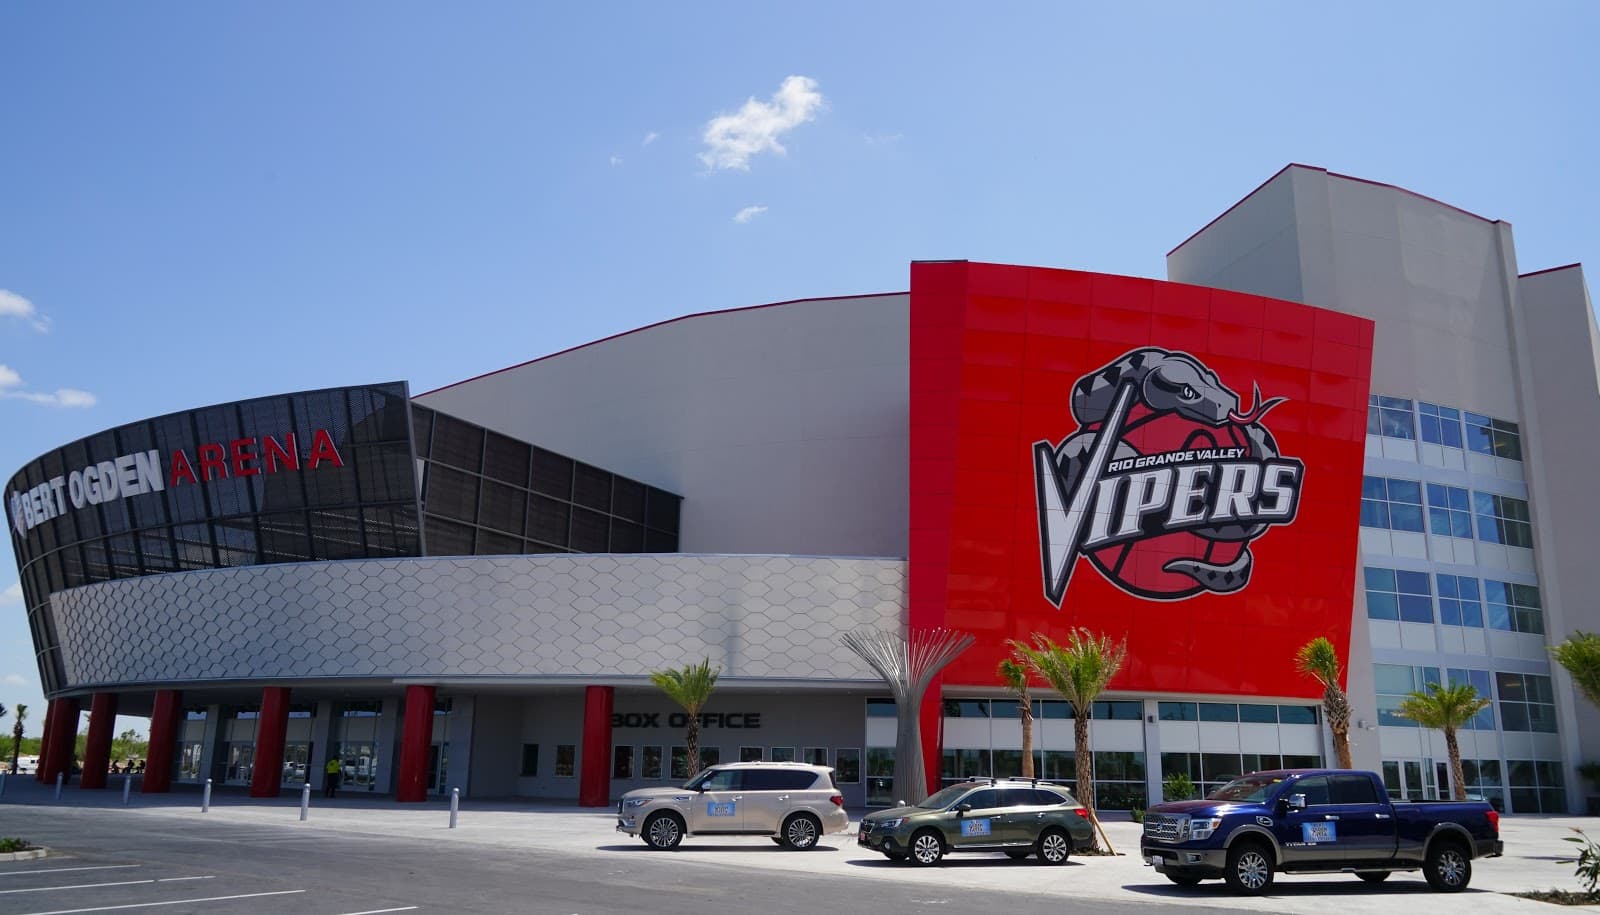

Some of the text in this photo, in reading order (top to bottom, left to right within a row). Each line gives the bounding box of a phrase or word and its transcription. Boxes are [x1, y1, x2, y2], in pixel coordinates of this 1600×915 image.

[22, 429, 344, 530] BERT OGDEN ARENA
[1039, 383, 1298, 594] VIPERS
[1108, 448, 1245, 472] RIO GRANDE VALLEY
[668, 713, 761, 728] OFICE
